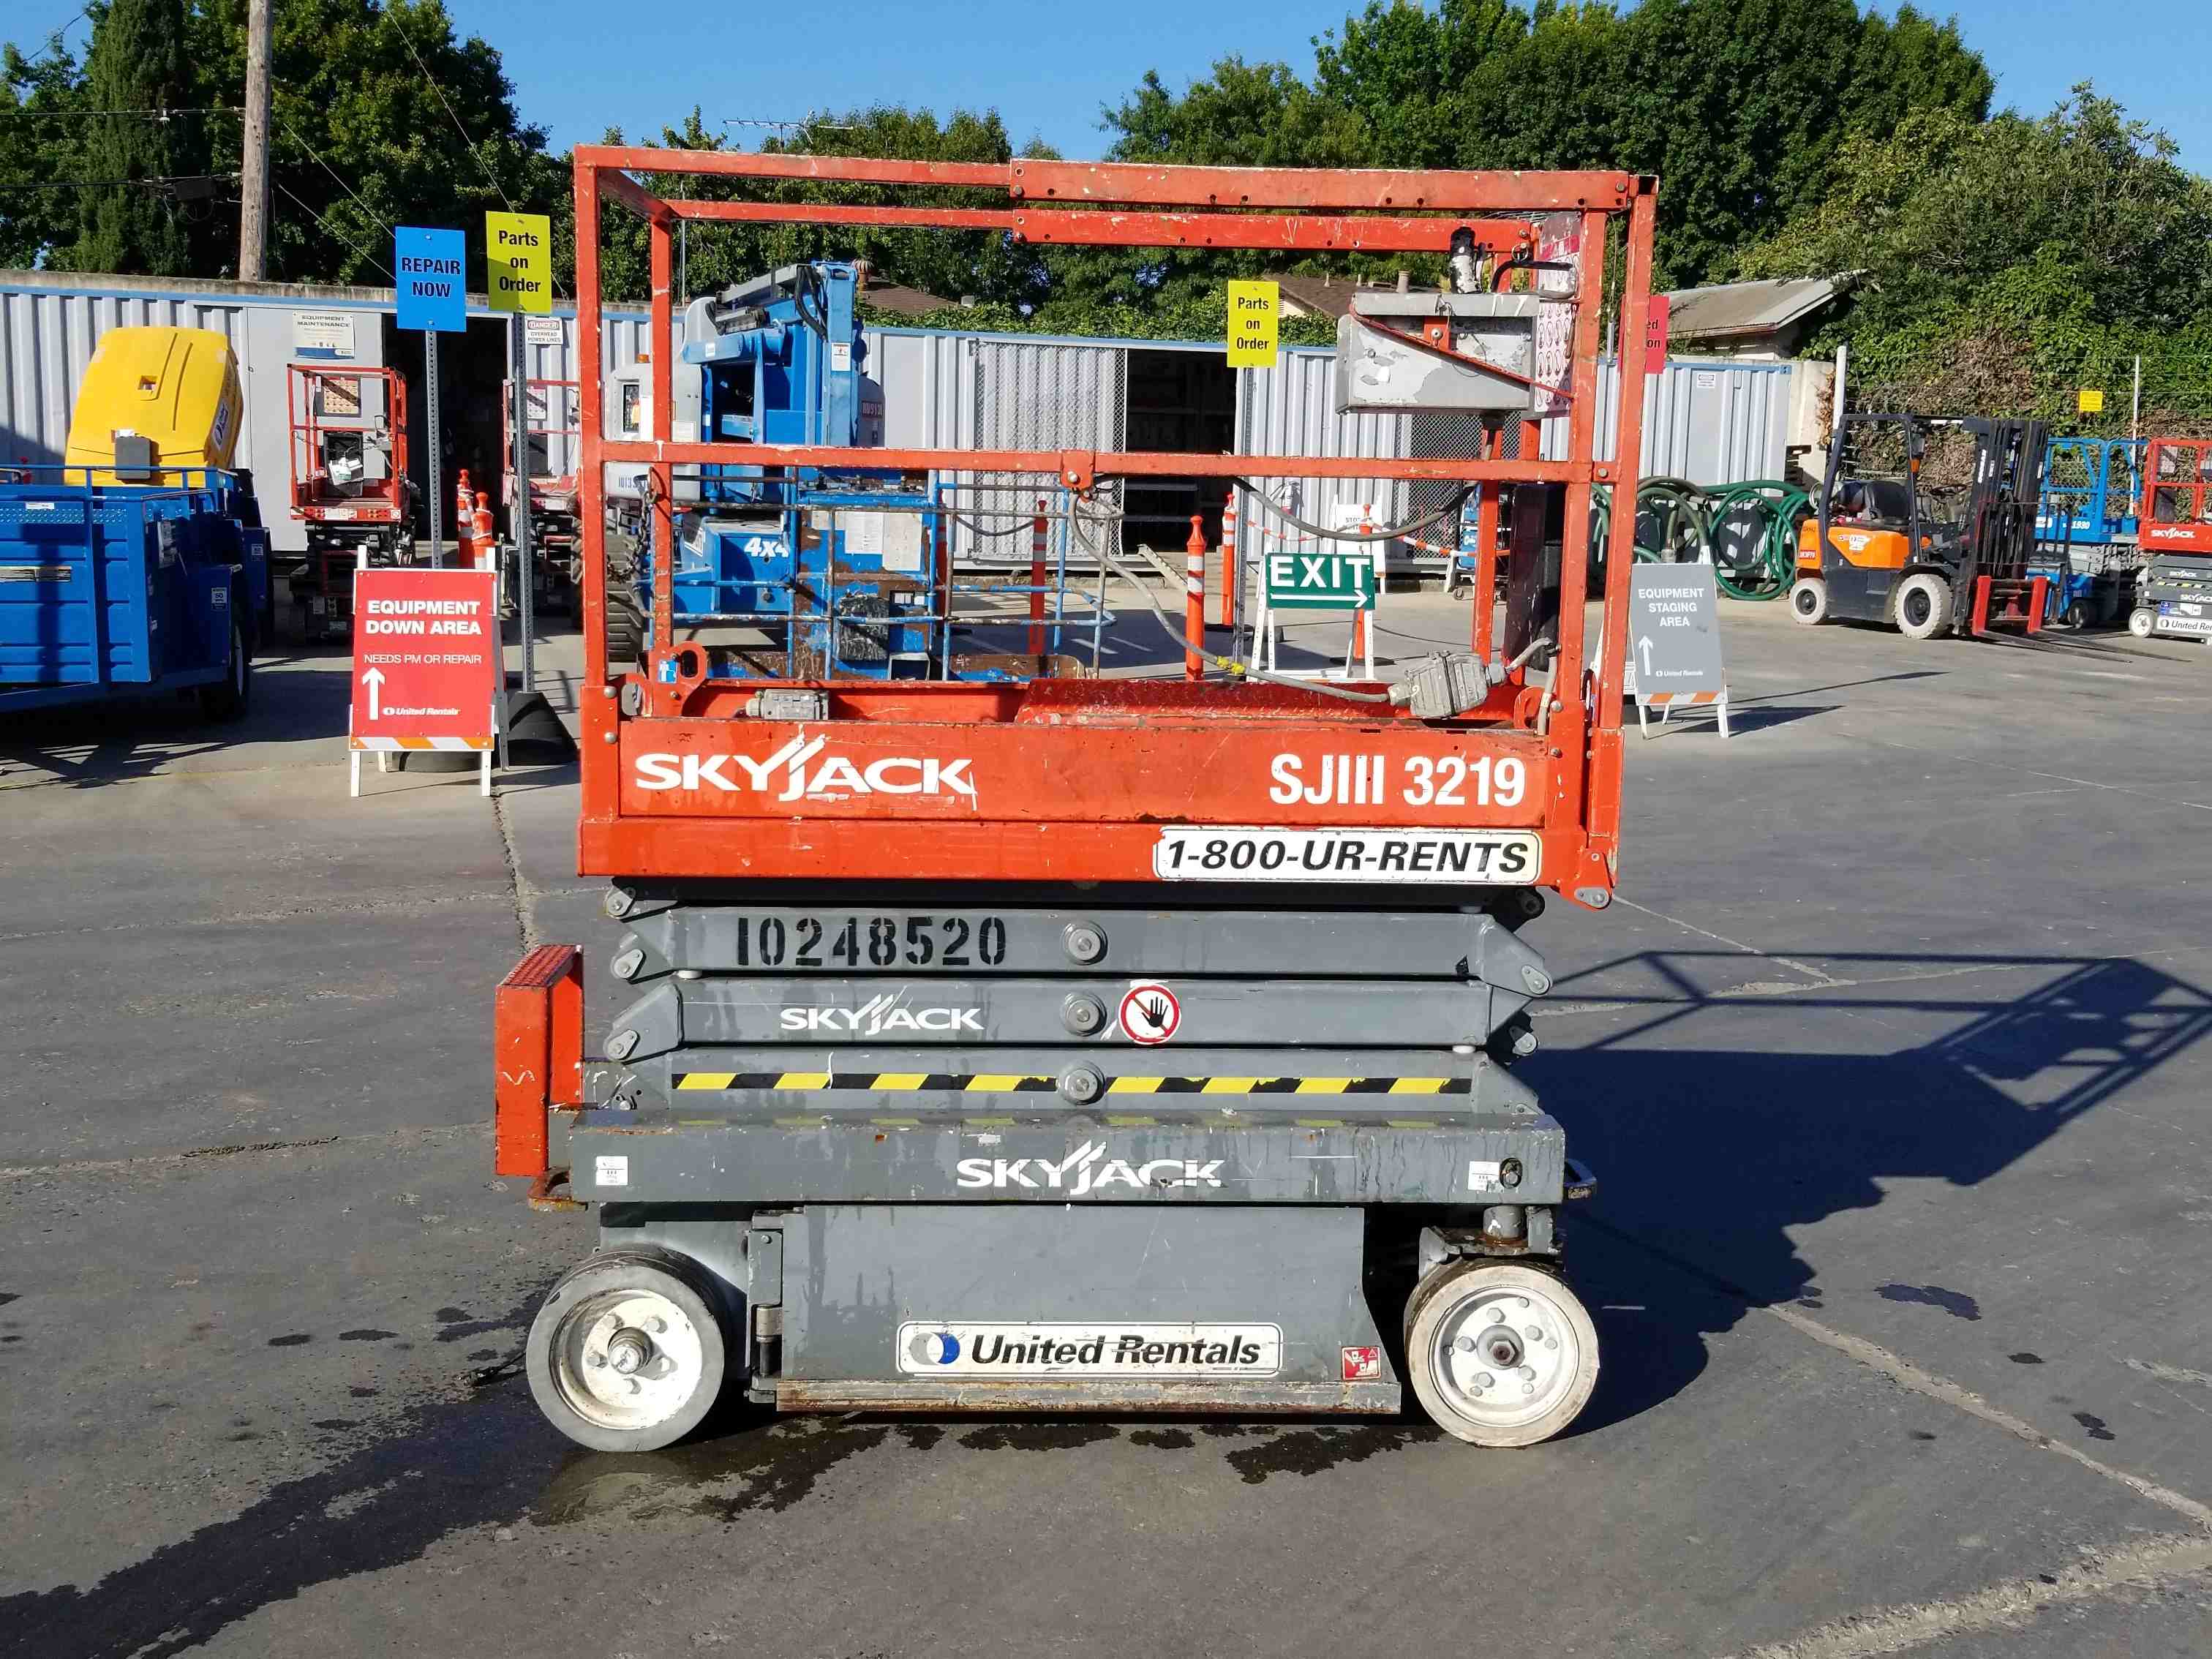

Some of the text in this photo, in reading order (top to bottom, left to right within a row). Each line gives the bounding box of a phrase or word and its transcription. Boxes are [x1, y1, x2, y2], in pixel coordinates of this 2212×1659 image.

[499, 230, 538, 247] Parts
[402, 257, 461, 275] REPAIR
[510, 257, 529, 269] on
[412, 282, 451, 298] NOW
[499, 276, 541, 293] Order
[1238, 297, 1269, 310] Parts
[1246, 320, 1260, 330] on
[1236, 336, 1269, 350] Order
[2151, 527, 2196, 539] SKYJACK
[744, 538, 789, 557] 4x4
[1270, 556, 1370, 588] EXIT
[2169, 570, 2197, 578] SKYJACK
[1639, 587, 1705, 598] EQUIPMENT
[367, 600, 480, 615] EQUIPMENT
[1648, 602, 1698, 612] STAGING
[366, 620, 482, 635] DOWN AREA
[1659, 616, 1690, 627] AREA
[2171, 620, 2198, 630] United
[364, 654, 481, 663] NEEDS PM OR REPAIR
[396, 707, 461, 715] United Rentals
[634, 734, 977, 801] SKYJACK
[1269, 753, 1526, 807] SJIII 3219
[1167, 839, 1529, 874] 1-800-UR-RENTS
[737, 916, 1007, 966] 10248520
[780, 993, 985, 1036] SKYJACK
[955, 1140, 1227, 1195] SKYJACK
[971, 1333, 1261, 1365] United Rentals
